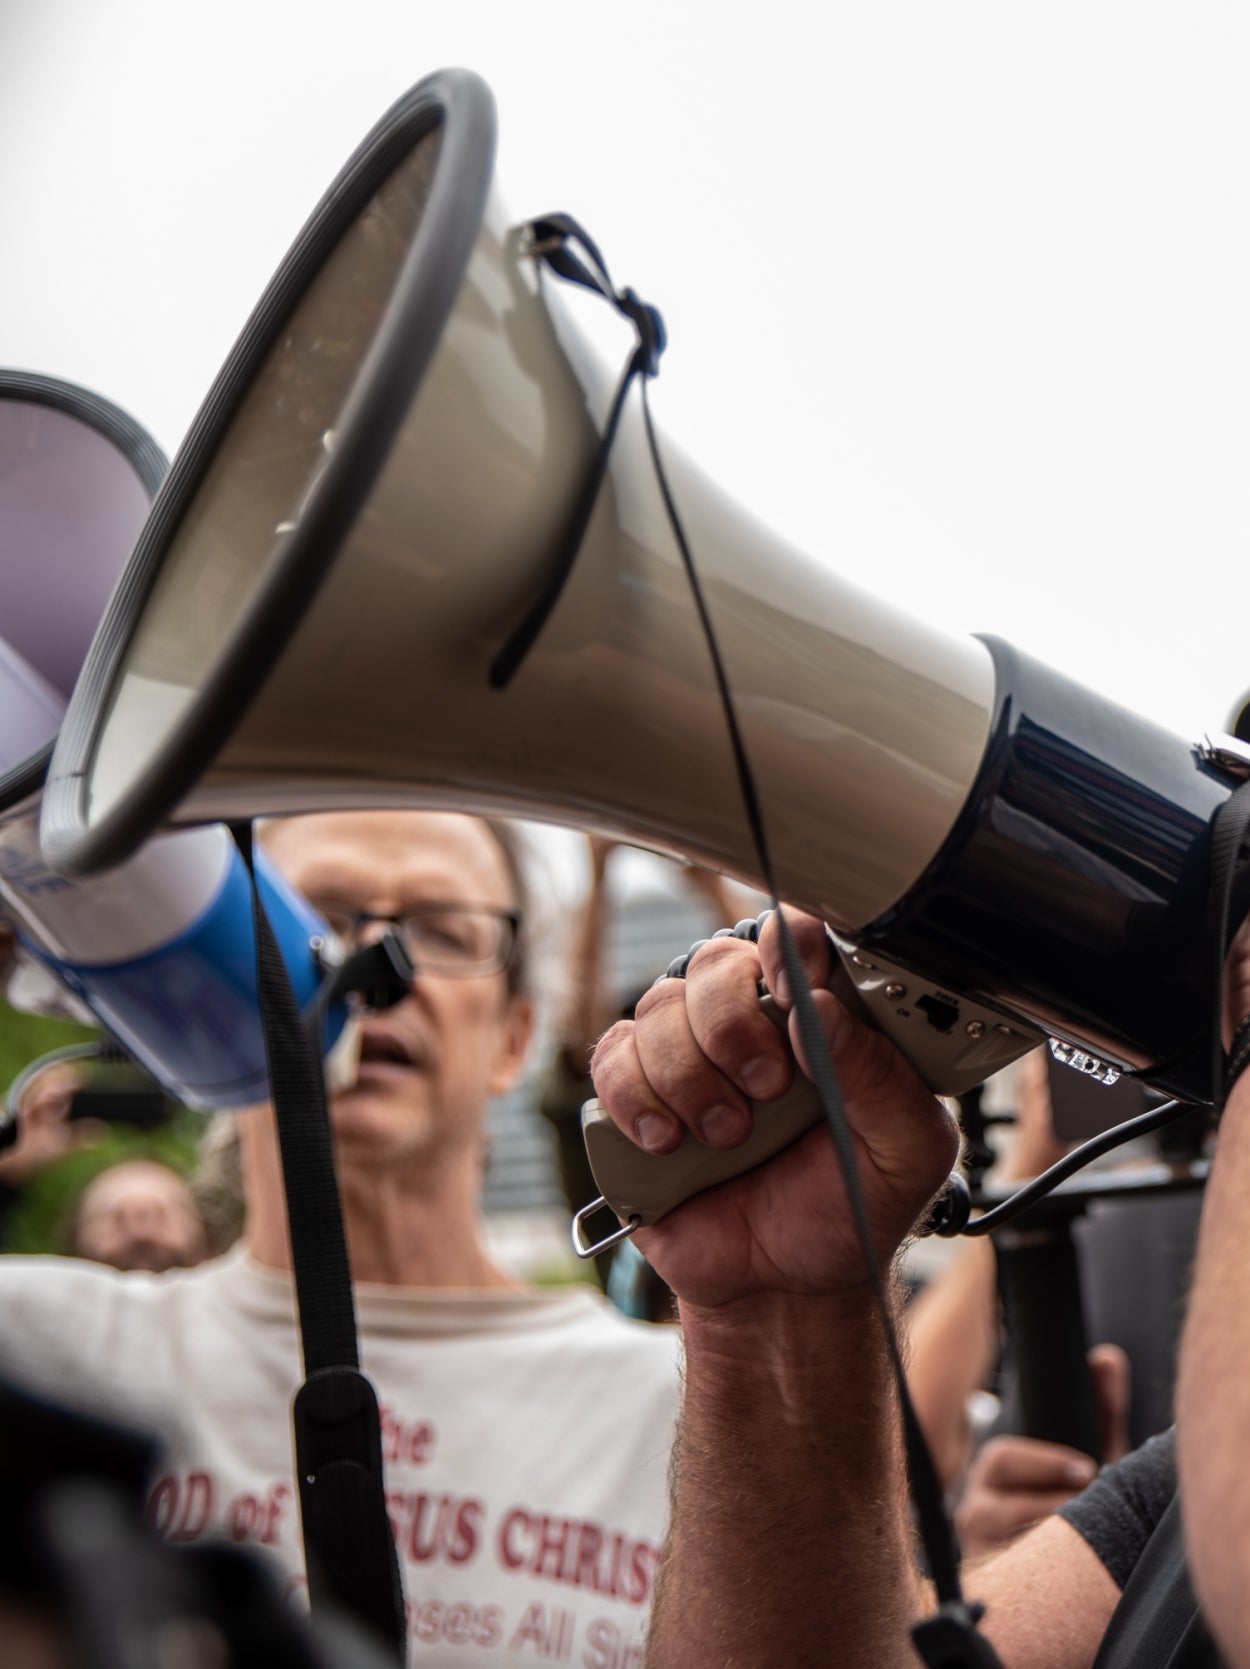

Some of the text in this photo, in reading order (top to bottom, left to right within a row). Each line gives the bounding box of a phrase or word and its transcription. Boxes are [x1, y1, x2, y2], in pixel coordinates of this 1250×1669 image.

[379, 1403, 435, 1465] he
[150, 1473, 213, 1543] OD
[232, 1484, 292, 1543] of
[498, 1505, 663, 1607] CHRIS
[405, 1600, 504, 1648] ses
[510, 1602, 577, 1664] All
